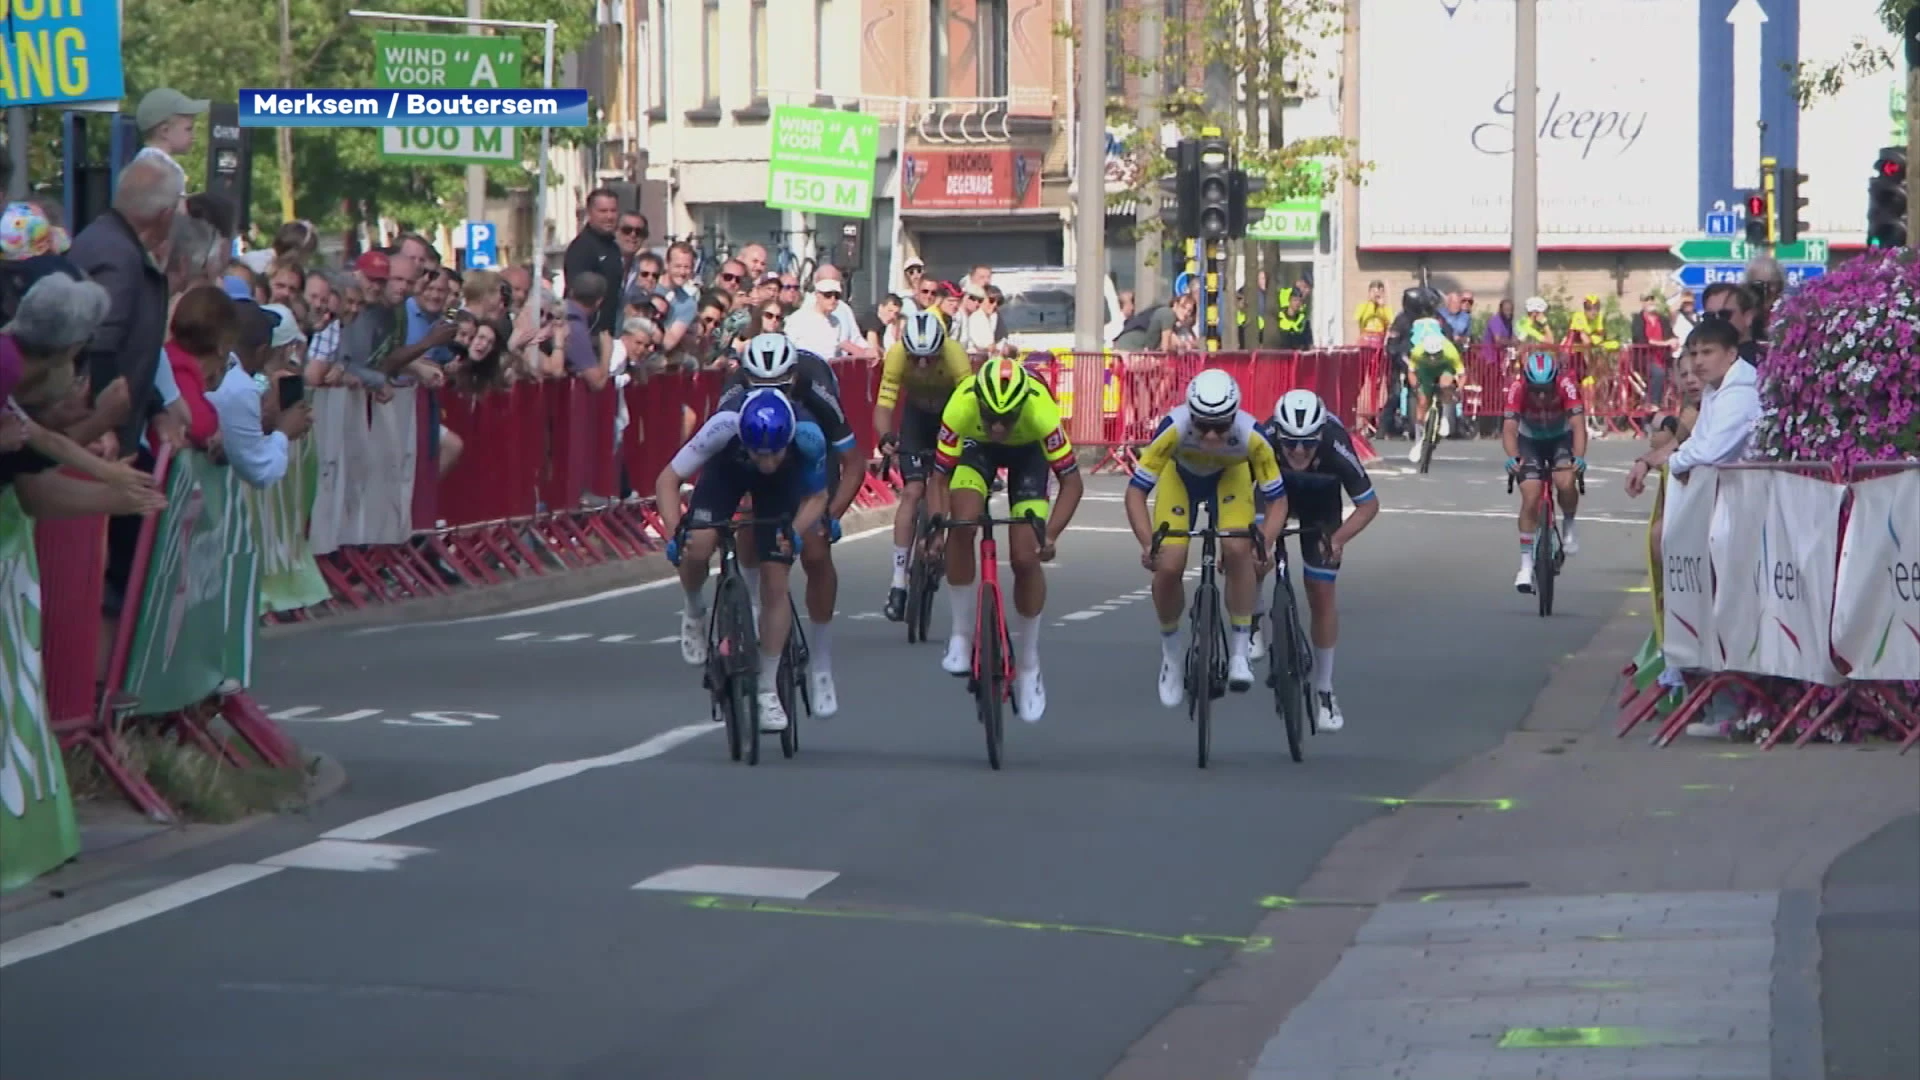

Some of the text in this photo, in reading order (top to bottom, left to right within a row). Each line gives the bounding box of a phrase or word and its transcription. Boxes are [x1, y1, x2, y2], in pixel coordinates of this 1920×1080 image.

[384, 47, 446, 66] WIND
[384, 66, 446, 85] VOOR
[780, 116, 824, 134] WIND
[395, 126, 503, 153] 100 M
[780, 134, 822, 151] VOOR
[783, 176, 858, 206] 150 M
[471, 224, 491, 250] P
